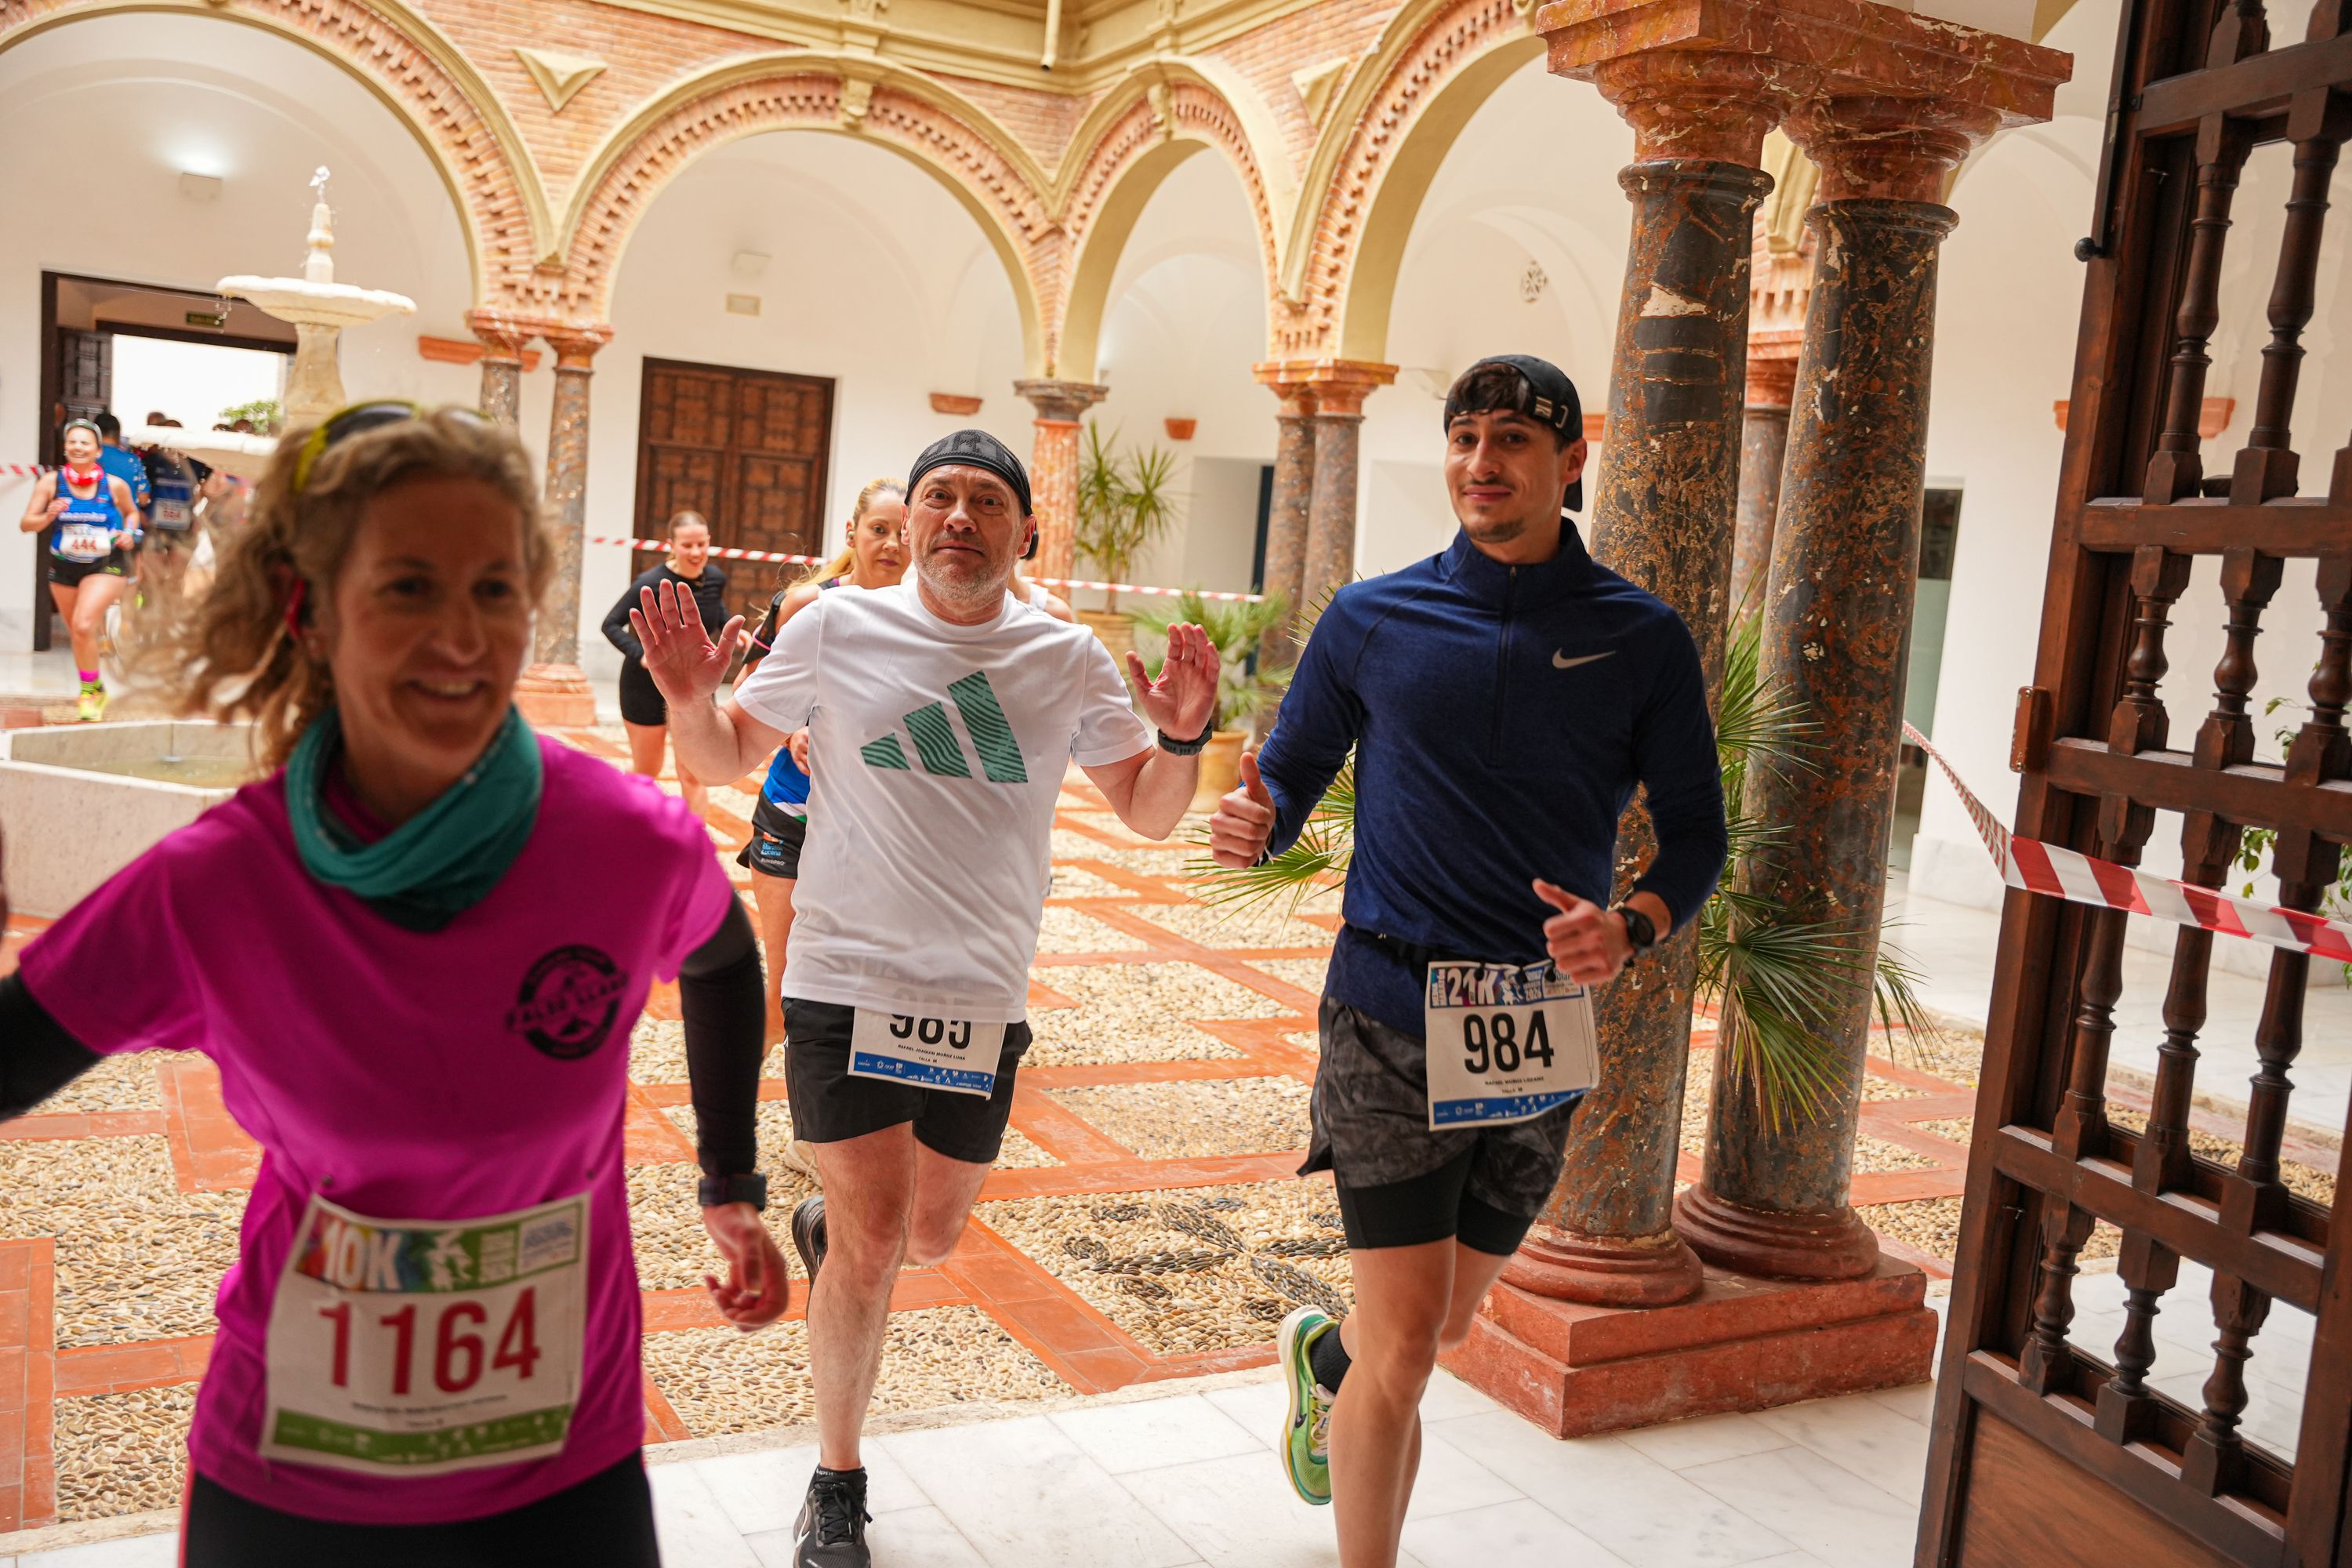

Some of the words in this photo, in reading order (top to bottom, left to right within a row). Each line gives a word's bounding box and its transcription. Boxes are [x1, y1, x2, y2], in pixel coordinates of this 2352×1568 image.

[72, 539, 96, 552] 444
[1463, 1010, 1555, 1074] 984
[322, 1218, 404, 1291] 10K
[318, 1287, 542, 1396] 1164
